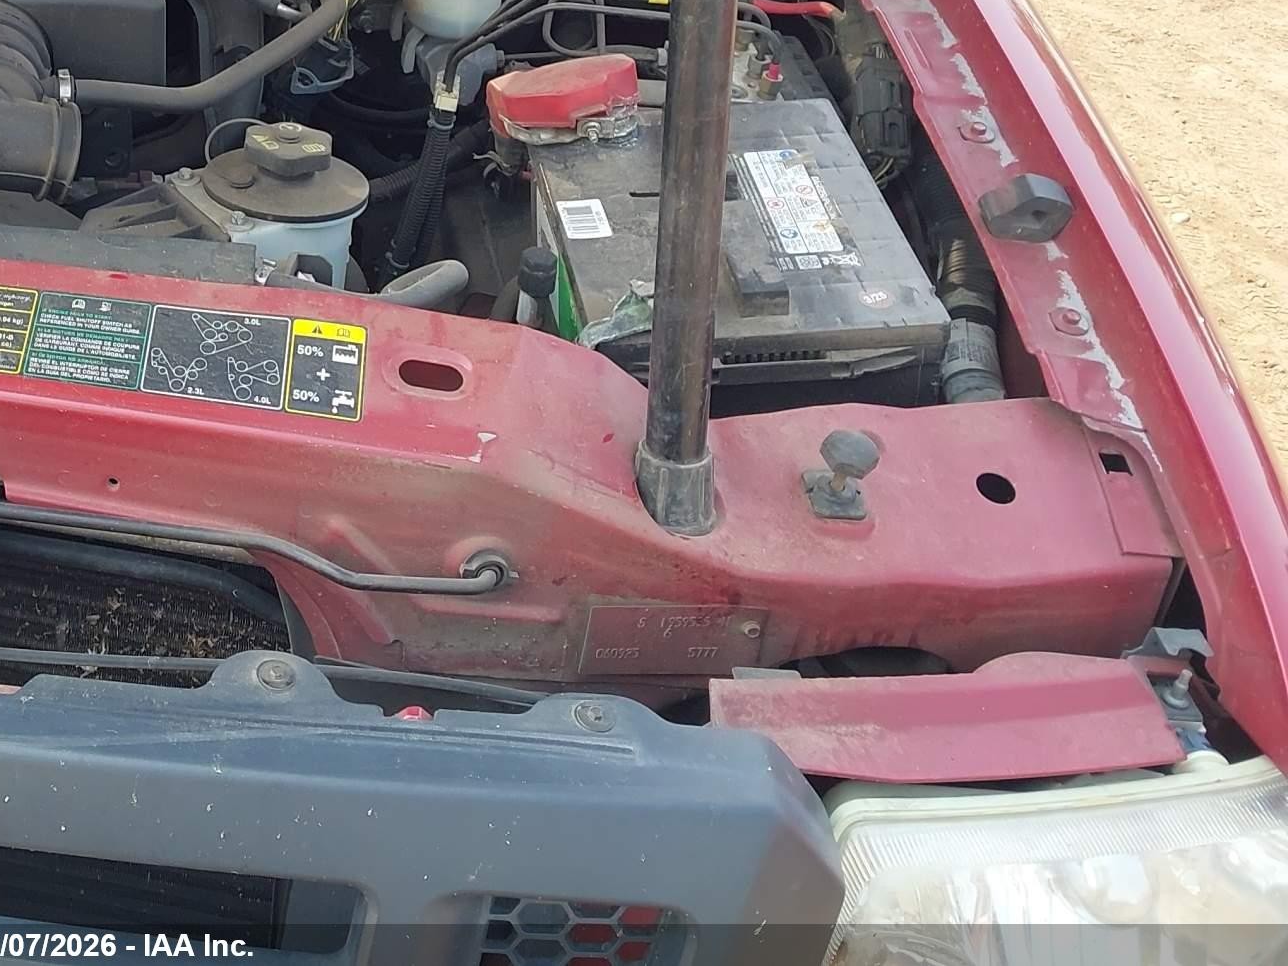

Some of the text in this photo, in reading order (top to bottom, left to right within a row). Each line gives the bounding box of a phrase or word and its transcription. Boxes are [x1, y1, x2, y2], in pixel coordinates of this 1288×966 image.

[244, 317, 261, 327] 3.0L
[297, 344, 324, 358] 50%
[187, 386, 205, 396] 2.3L
[253, 395, 272, 405] 4.0L
[292, 389, 320, 404] 50%
